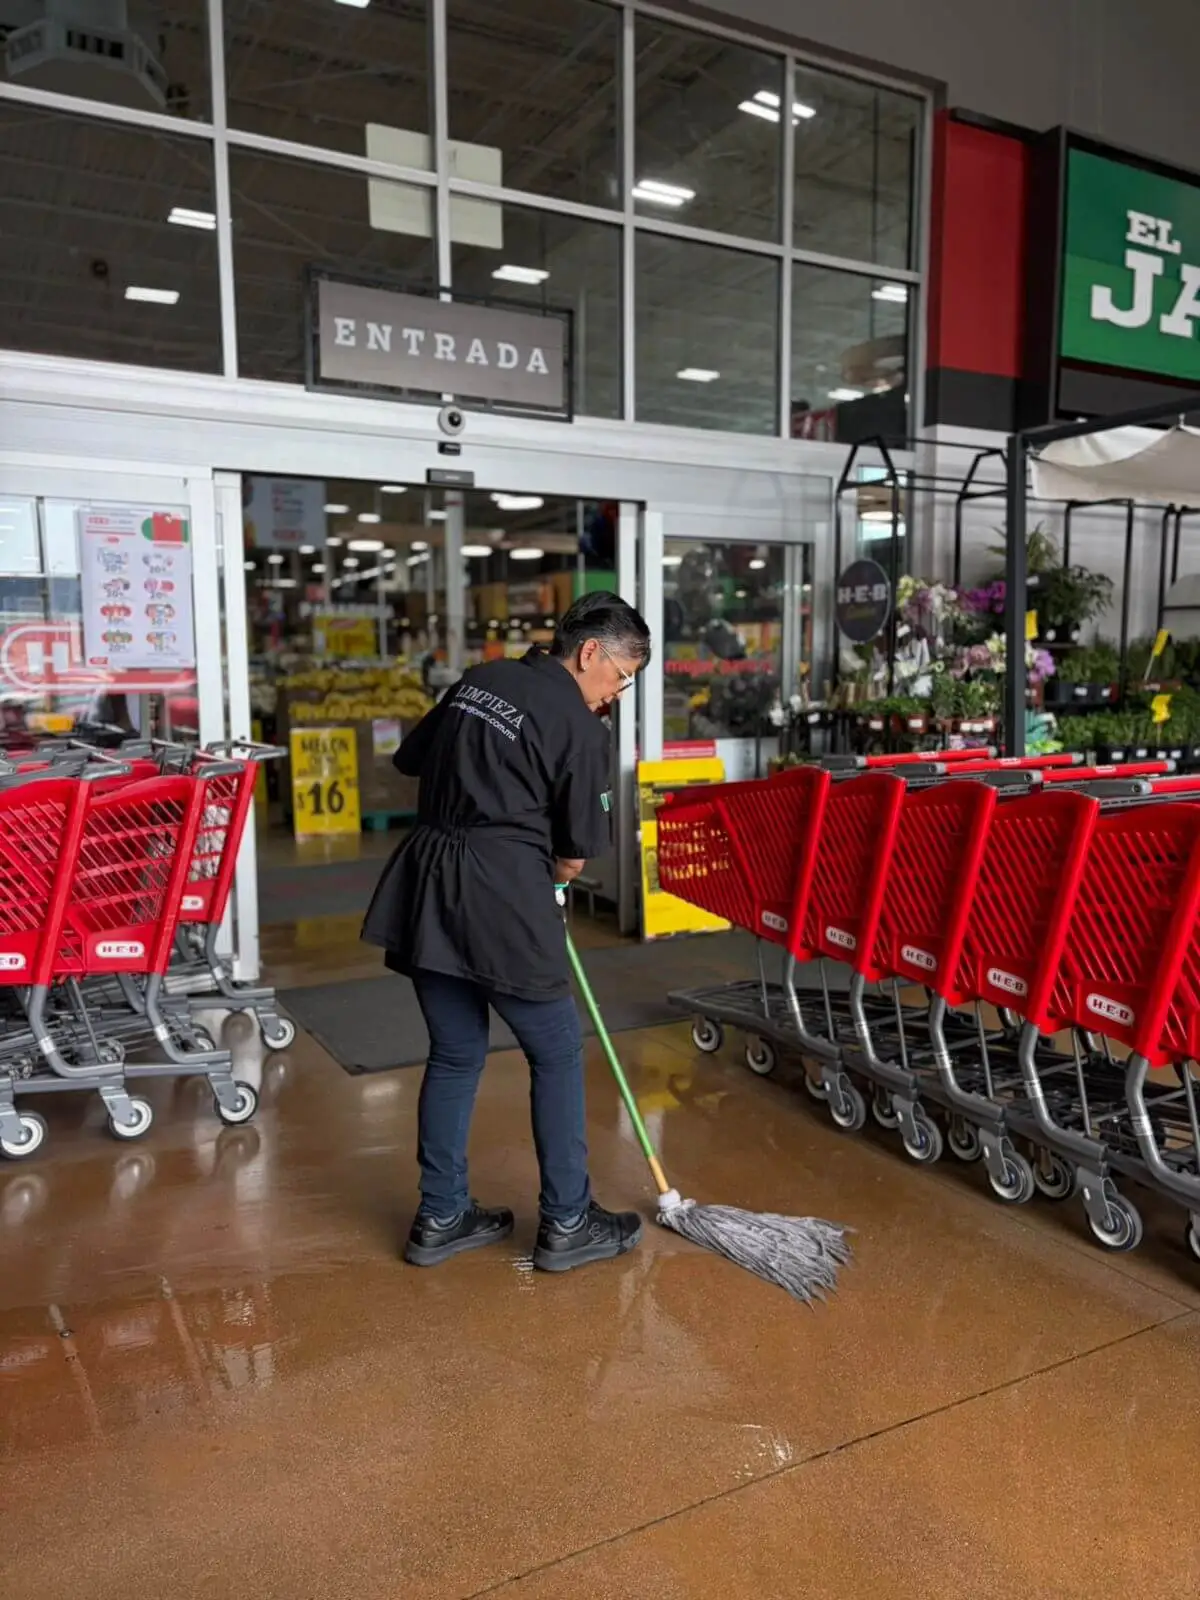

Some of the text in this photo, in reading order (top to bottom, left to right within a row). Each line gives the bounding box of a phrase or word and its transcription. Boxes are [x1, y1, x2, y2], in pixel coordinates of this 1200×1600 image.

[1125, 209, 1182, 256] EL
[333, 317, 549, 374] ENTRADA
[456, 684, 525, 730] LIMPIEZA
